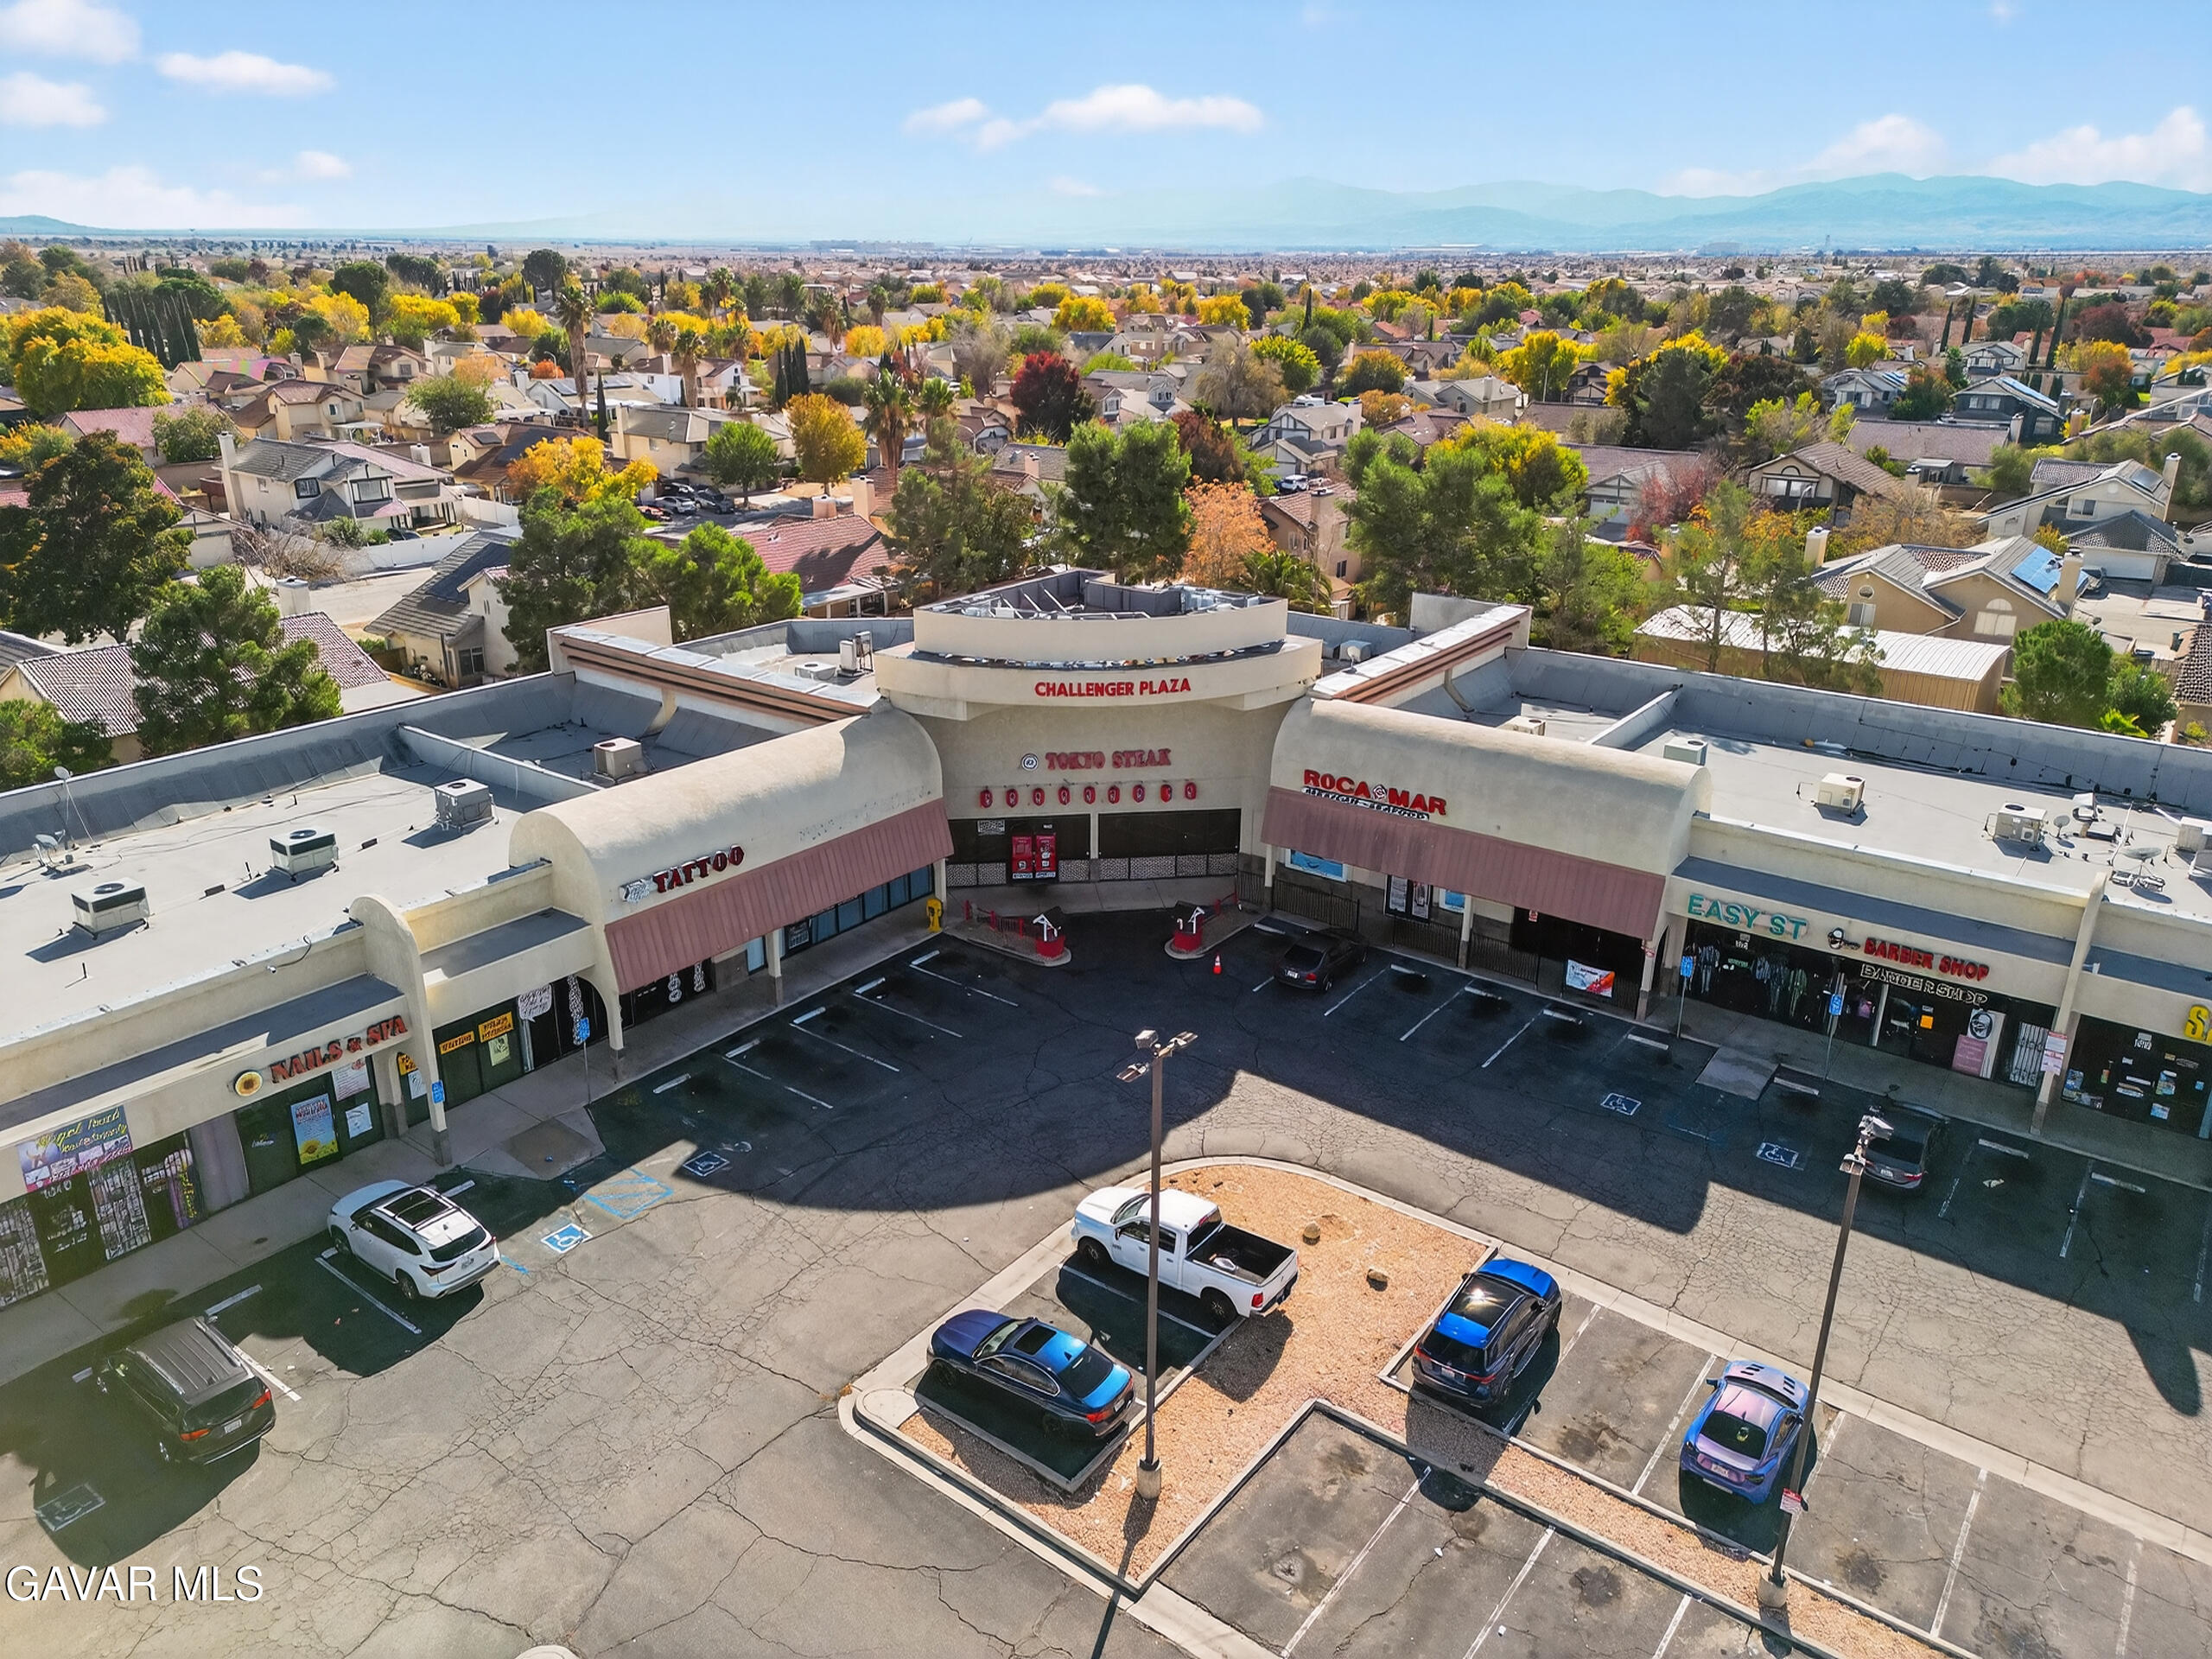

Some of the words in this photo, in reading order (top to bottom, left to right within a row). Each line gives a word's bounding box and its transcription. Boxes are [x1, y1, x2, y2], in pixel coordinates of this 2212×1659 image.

[1034, 681, 1135, 697] CHALLENGER
[1139, 678, 1192, 696] PLAZA
[1046, 751, 1106, 770] TOKYO
[1112, 748, 1172, 769] STEAK
[1303, 769, 1371, 798] ROCA
[1388, 787, 1446, 816] MAR
[652, 844, 745, 893] TATTOO
[1688, 893, 1760, 929] EASY
[1769, 913, 1808, 940] ST
[1863, 937, 1935, 969] BARBER
[1938, 956, 1990, 982] SHOP
[270, 1039, 344, 1084] NAILS
[366, 1014, 408, 1047] SPA
